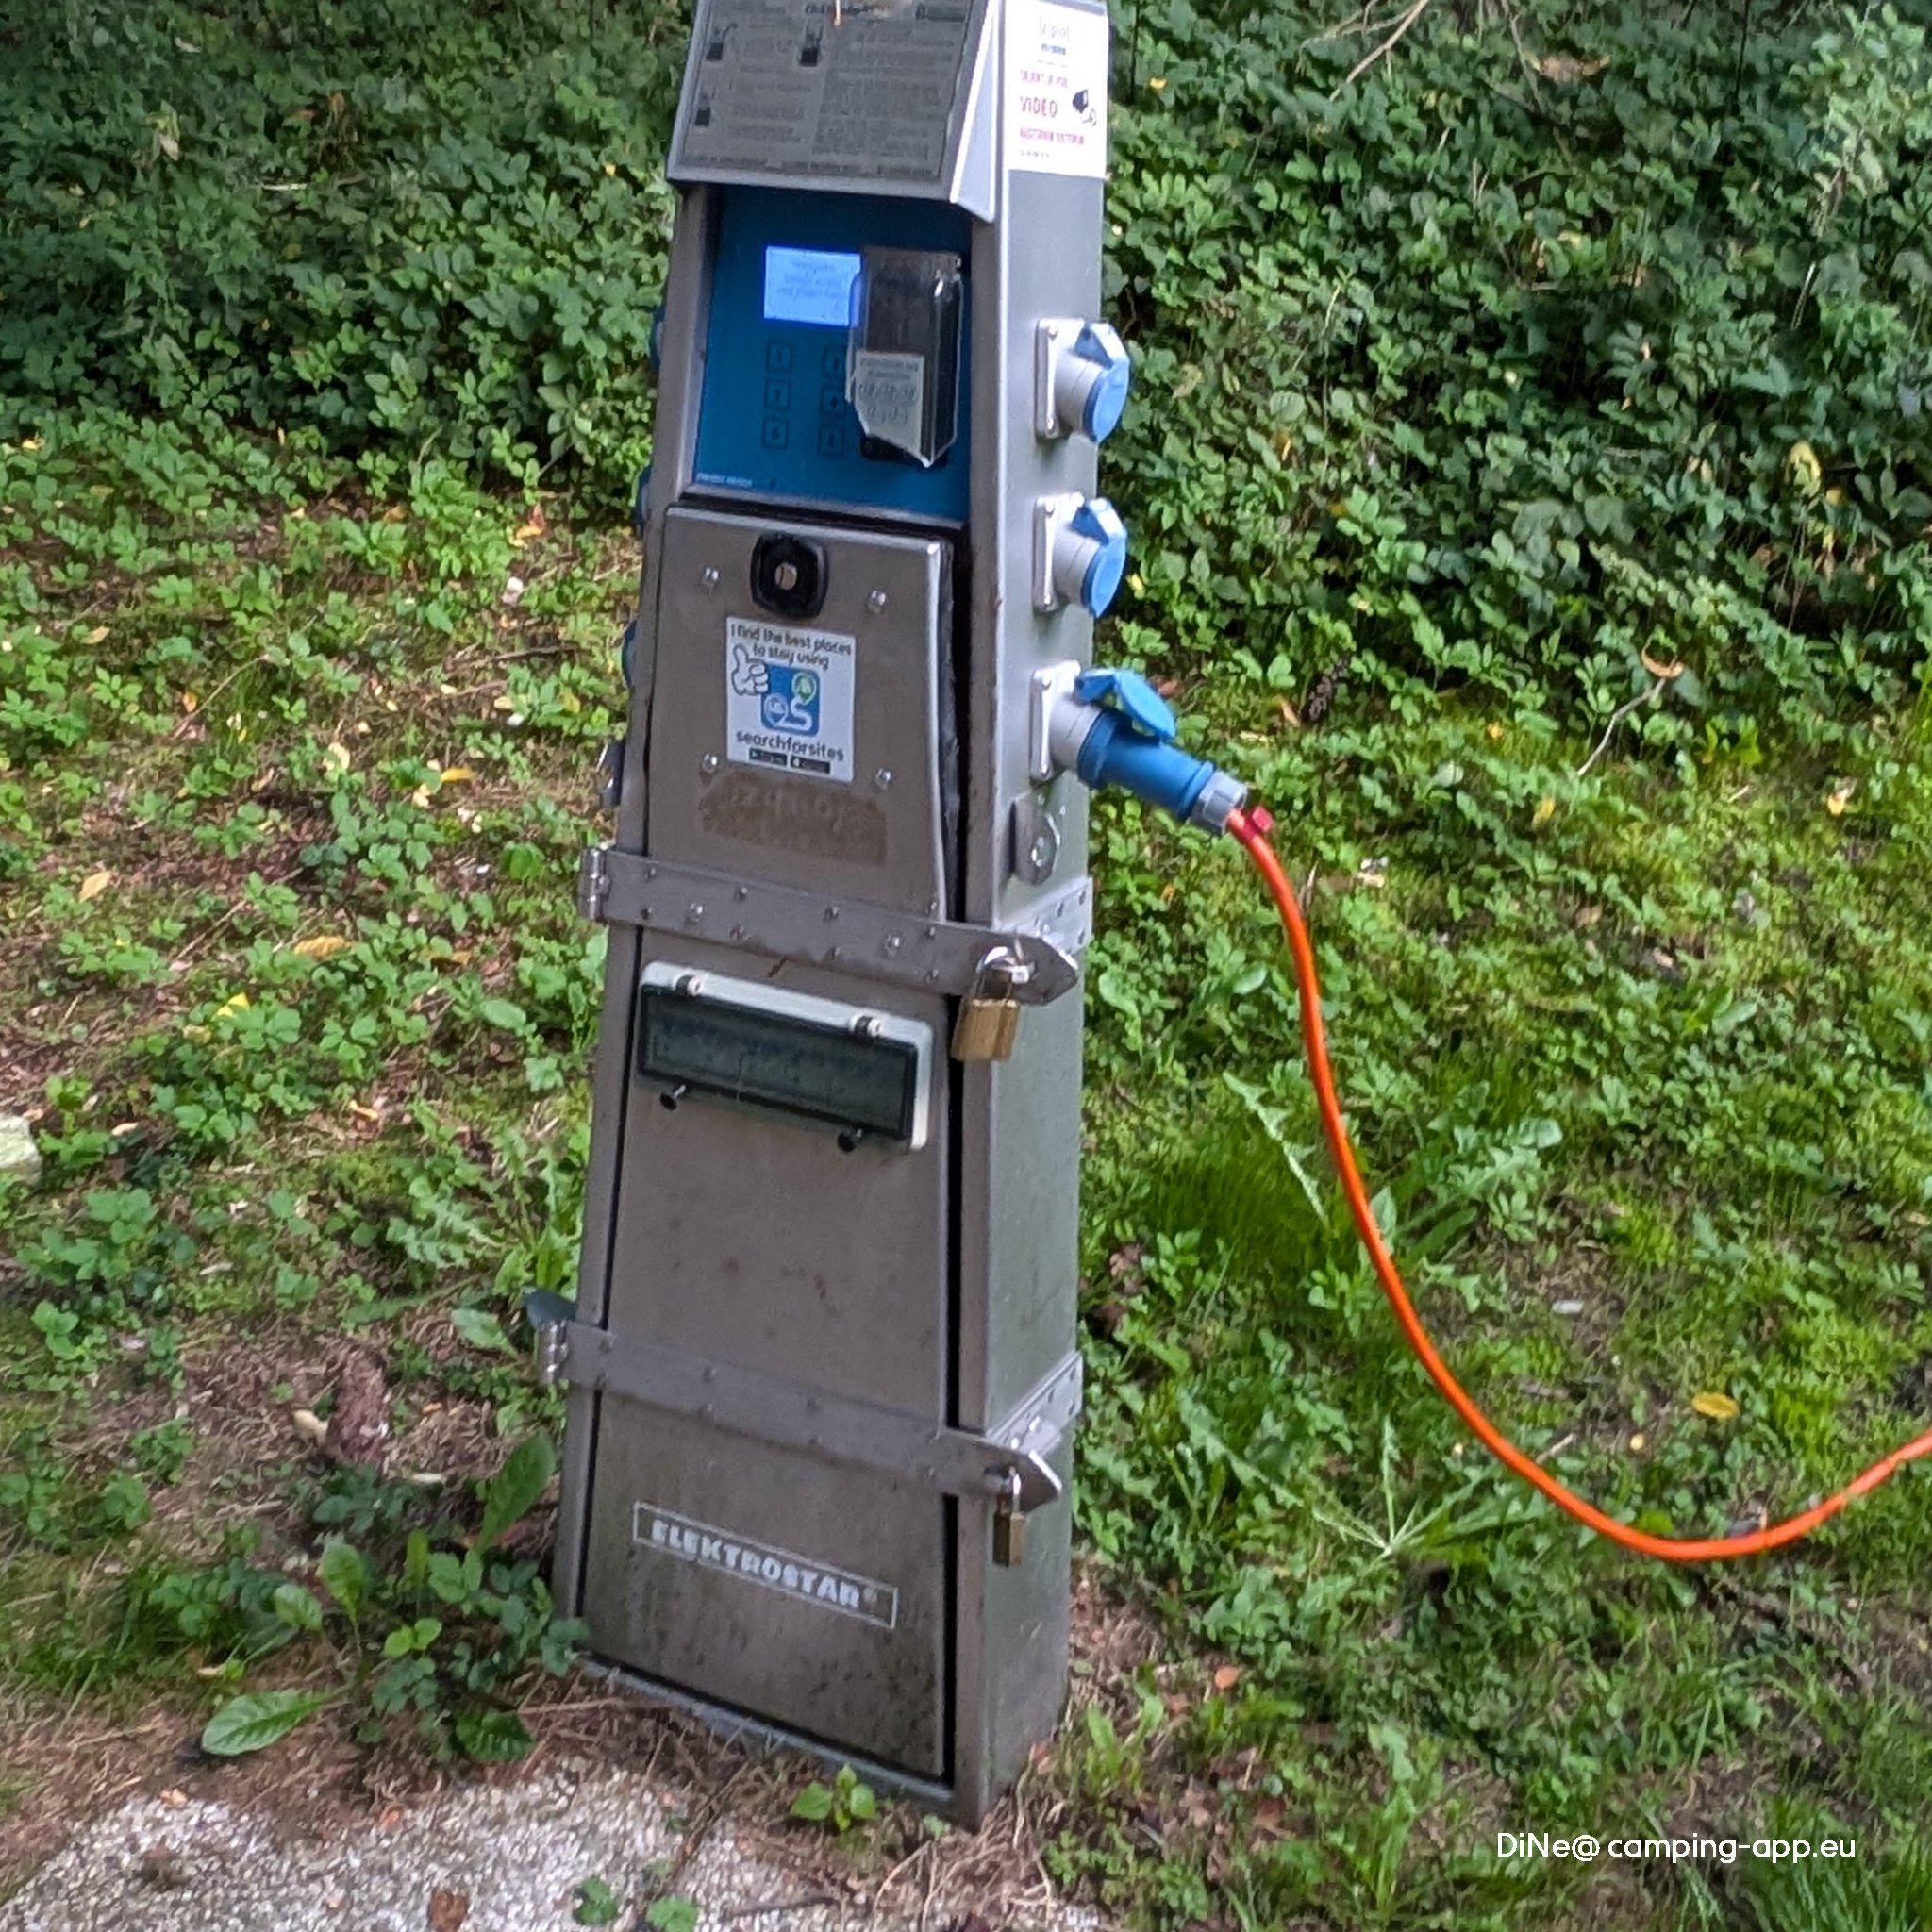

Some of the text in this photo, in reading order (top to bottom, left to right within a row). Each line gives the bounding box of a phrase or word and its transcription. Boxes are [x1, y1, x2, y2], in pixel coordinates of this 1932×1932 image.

[1021, 95, 1058, 118] VIDEO
[738, 625, 760, 641] find
[763, 628, 783, 643] the
[785, 631, 811, 649] best
[813, 638, 852, 656] places
[753, 642, 830, 670] to stay using
[736, 730, 844, 761] searchforsites
